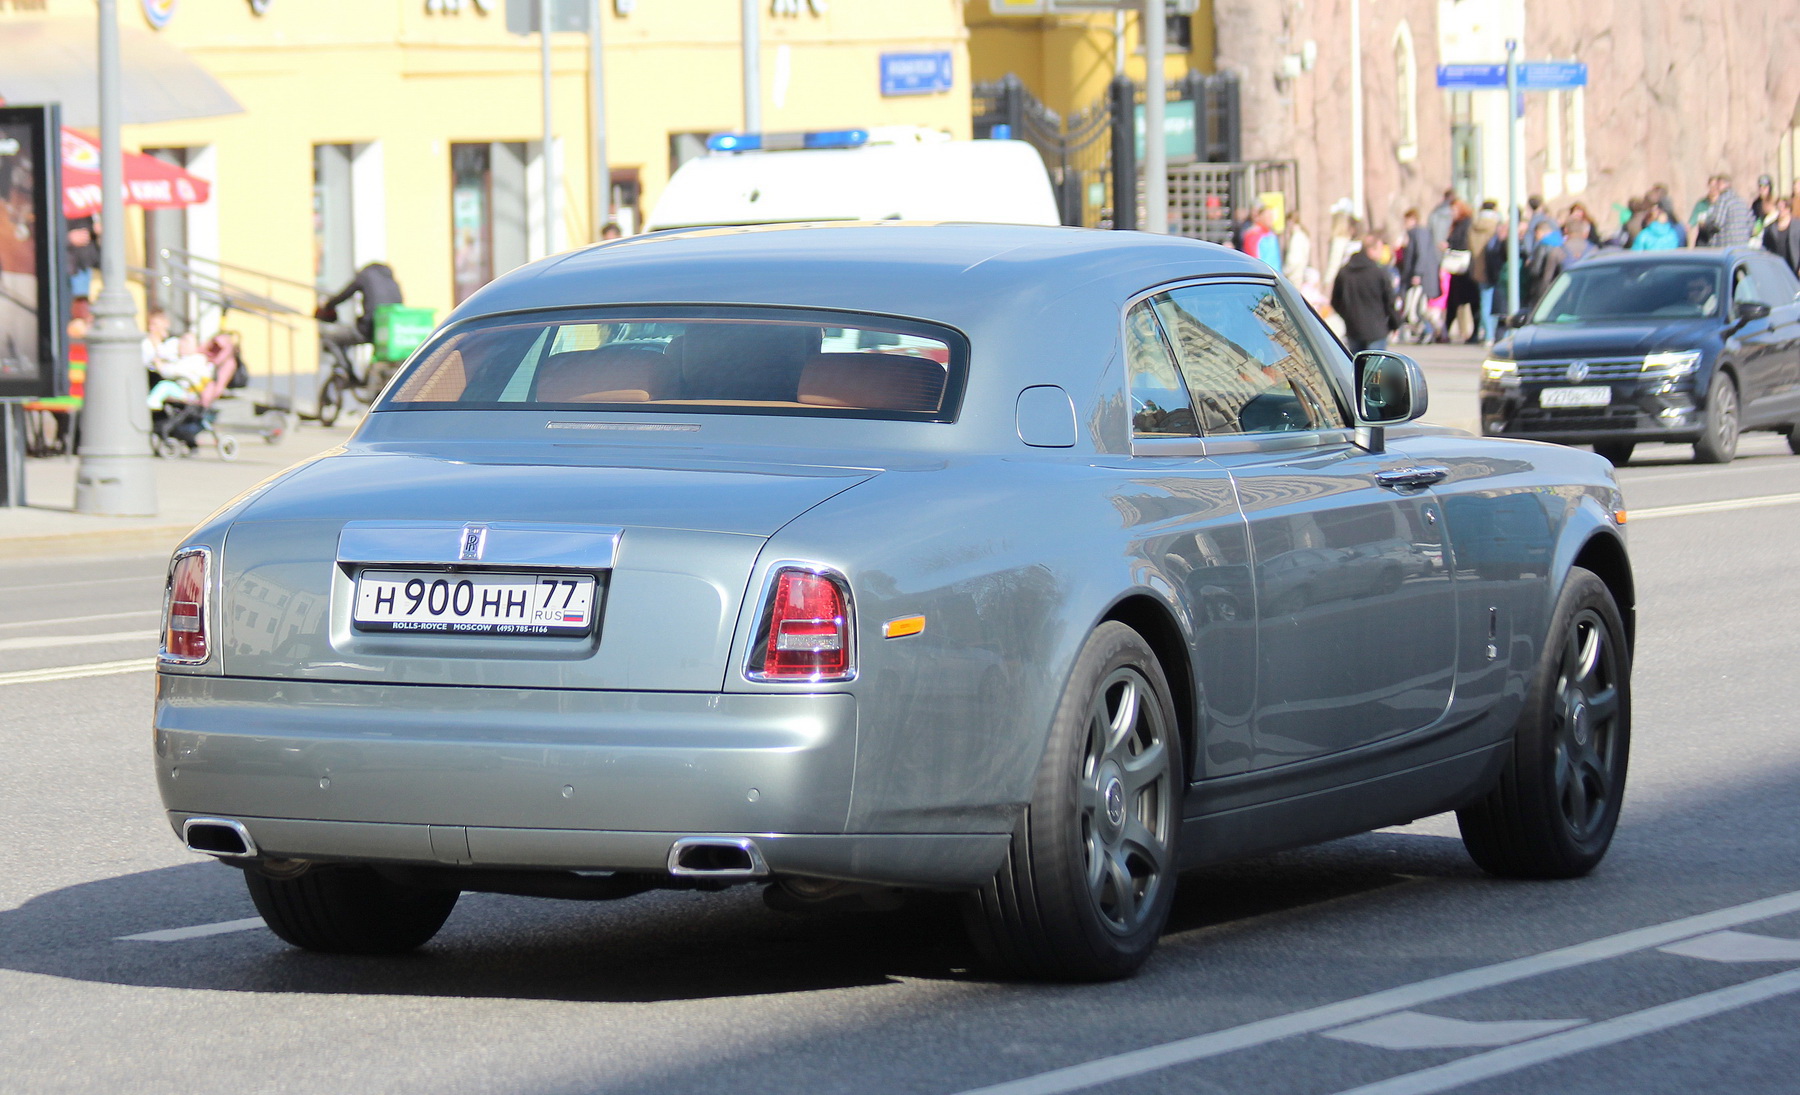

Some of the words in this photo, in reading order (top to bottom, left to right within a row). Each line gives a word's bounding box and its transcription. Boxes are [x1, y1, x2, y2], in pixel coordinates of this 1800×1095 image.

[542, 579, 578, 609] 77
[534, 610, 562, 621] RUS
[392, 622, 448, 631] ROLLS-ROYCE
[453, 623, 492, 632] MOSCOW
[496, 624, 515, 633] (495)
[515, 625, 548, 633] 785-1166
